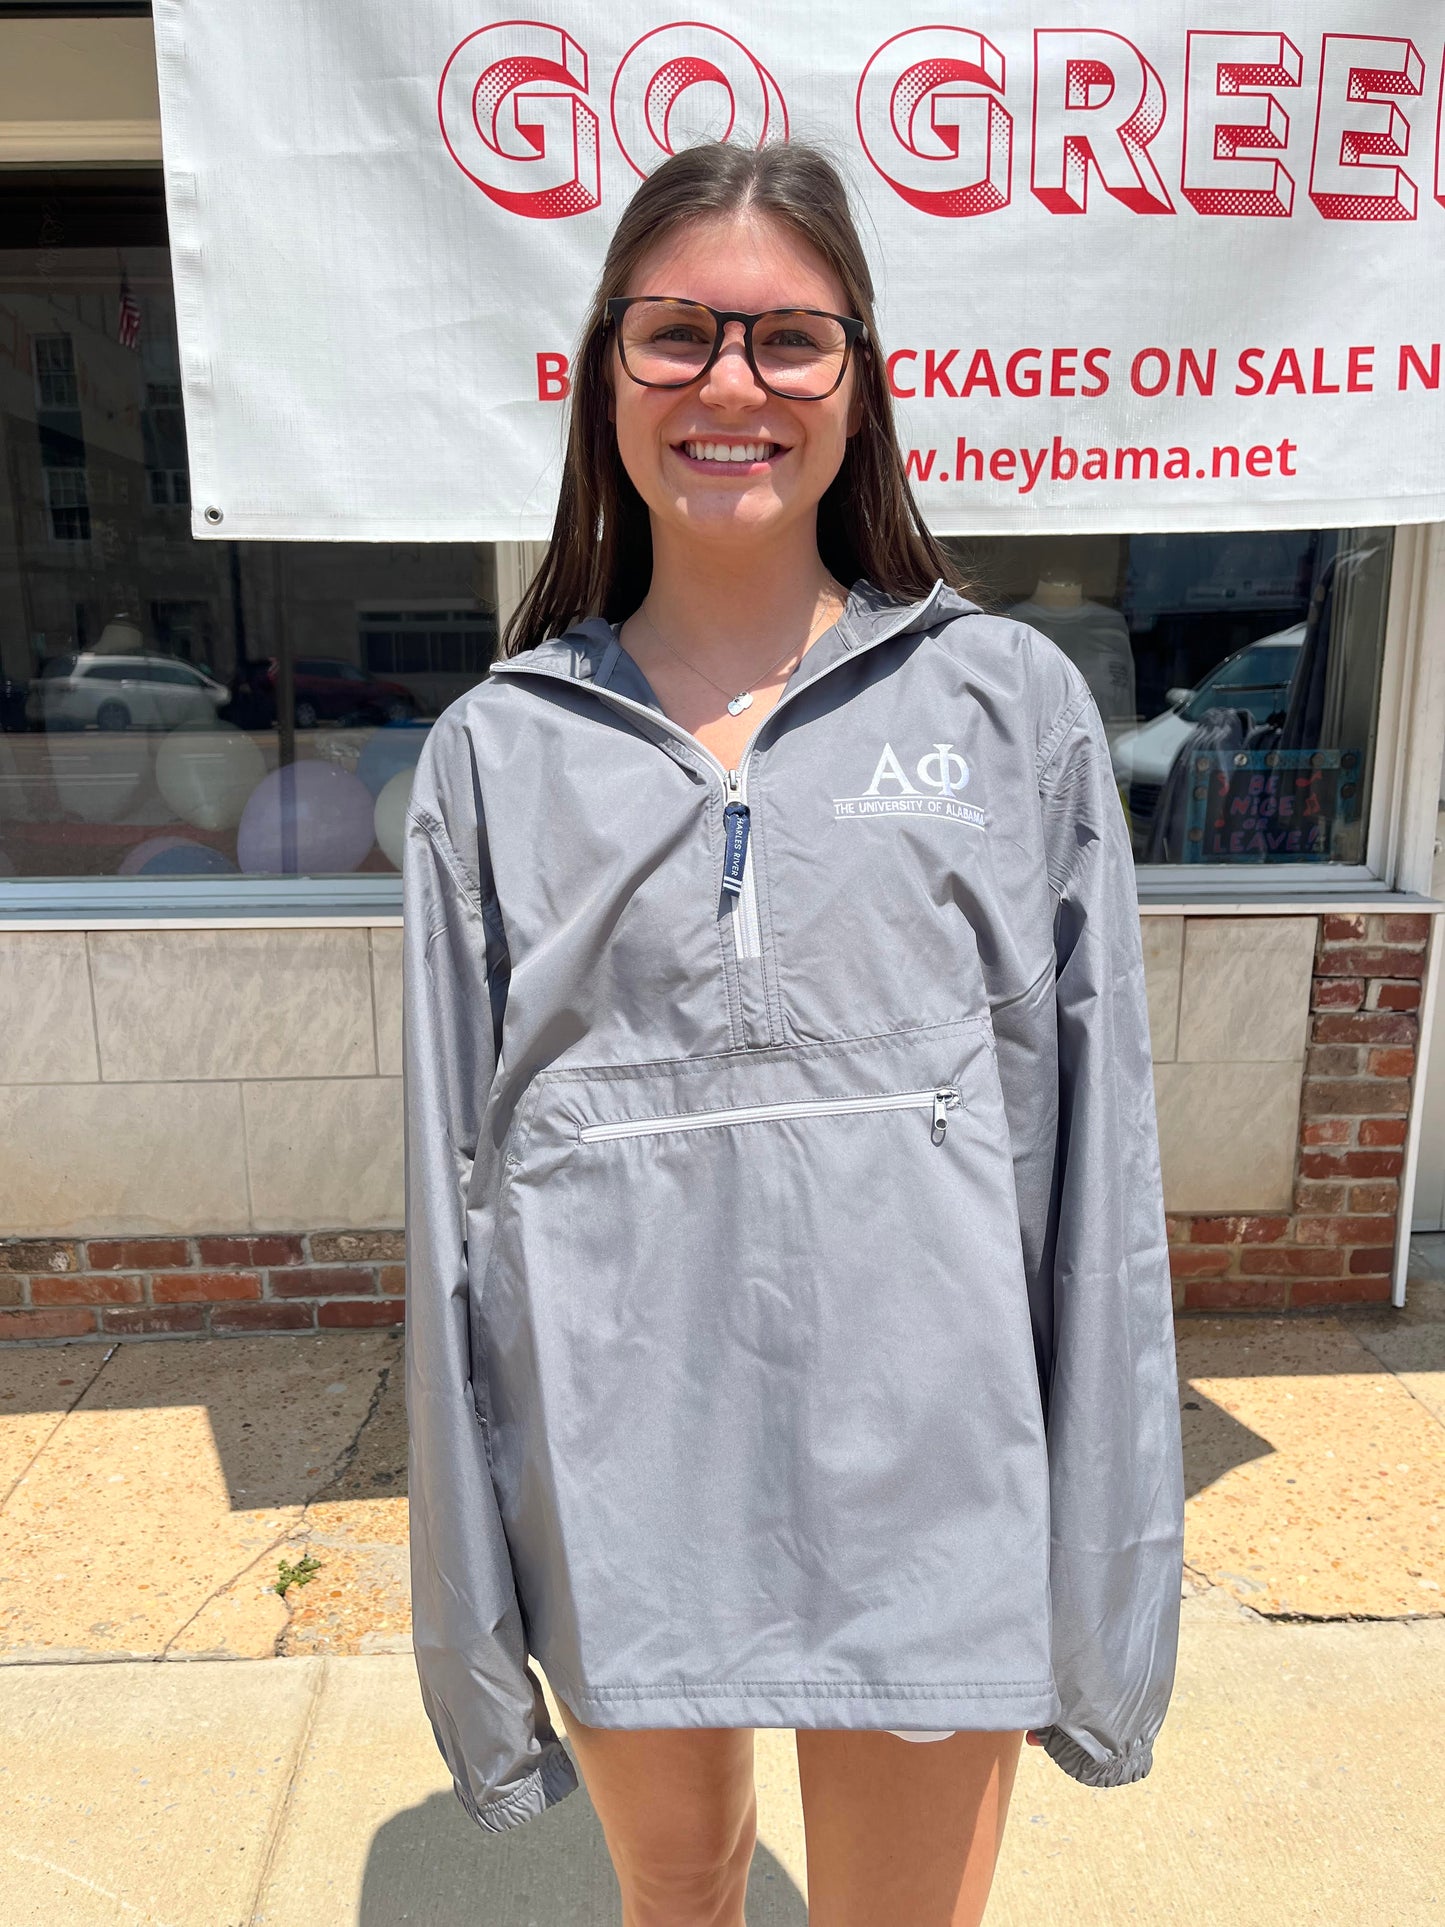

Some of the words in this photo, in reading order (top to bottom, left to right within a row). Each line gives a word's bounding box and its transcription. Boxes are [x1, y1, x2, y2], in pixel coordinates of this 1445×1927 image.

[856, 25, 1445, 220] GREE
[885, 348, 1112, 399] CKAGES
[1130, 346, 1217, 397] ON
[1235, 345, 1375, 396] SALE
[905, 436, 1297, 494] w.heybama.net
[1248, 774, 1280, 795] BE
[834, 803, 855, 816] THE
[858, 800, 924, 814] UNIVERSITY
[927, 801, 943, 813] OF
[946, 803, 985, 825] ALABAMA
[733, 813, 745, 851] HARLES
[731, 851, 742, 877] RIVER
